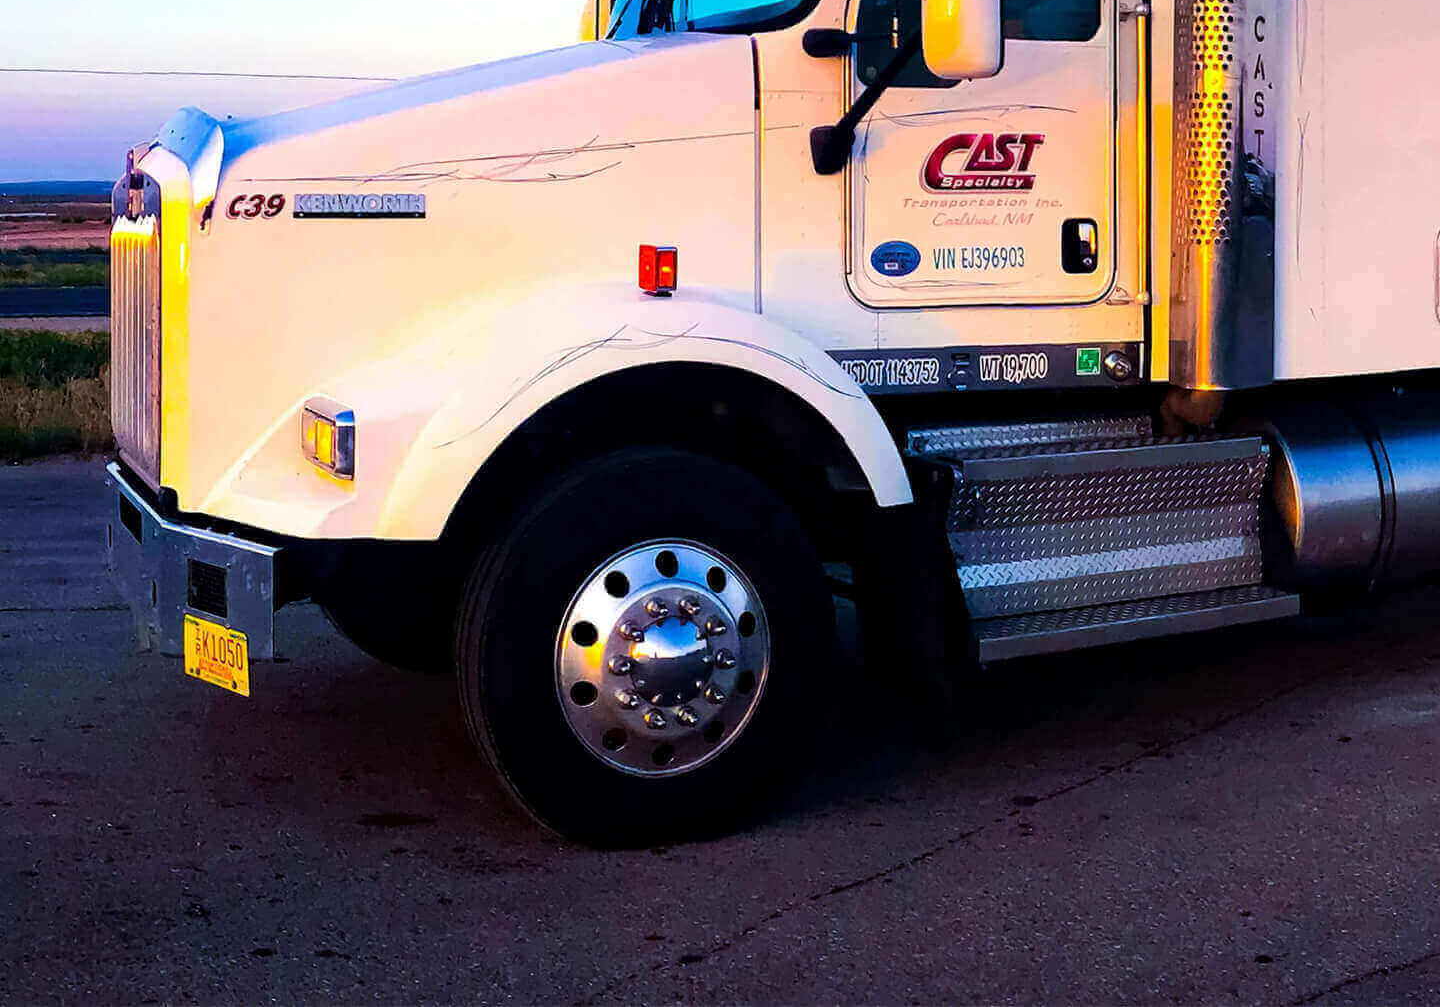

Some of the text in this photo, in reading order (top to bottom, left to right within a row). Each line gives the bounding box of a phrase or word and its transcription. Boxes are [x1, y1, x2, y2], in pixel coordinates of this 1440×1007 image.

[1254, 15, 1265, 158] CAST
[922, 133, 1046, 192] CAST
[941, 176, 1024, 190] Specialty
[226, 193, 426, 219] C39 KENWORTH
[903, 198, 1028, 209] Transportation
[1002, 212, 1034, 226] NM
[933, 248, 956, 270] VIN
[961, 246, 1025, 271] EJ396903
[886, 357, 940, 385] 1143752
[979, 354, 1001, 382] WT
[1001, 352, 1049, 384] 19,700
[202, 630, 244, 671] K1050
